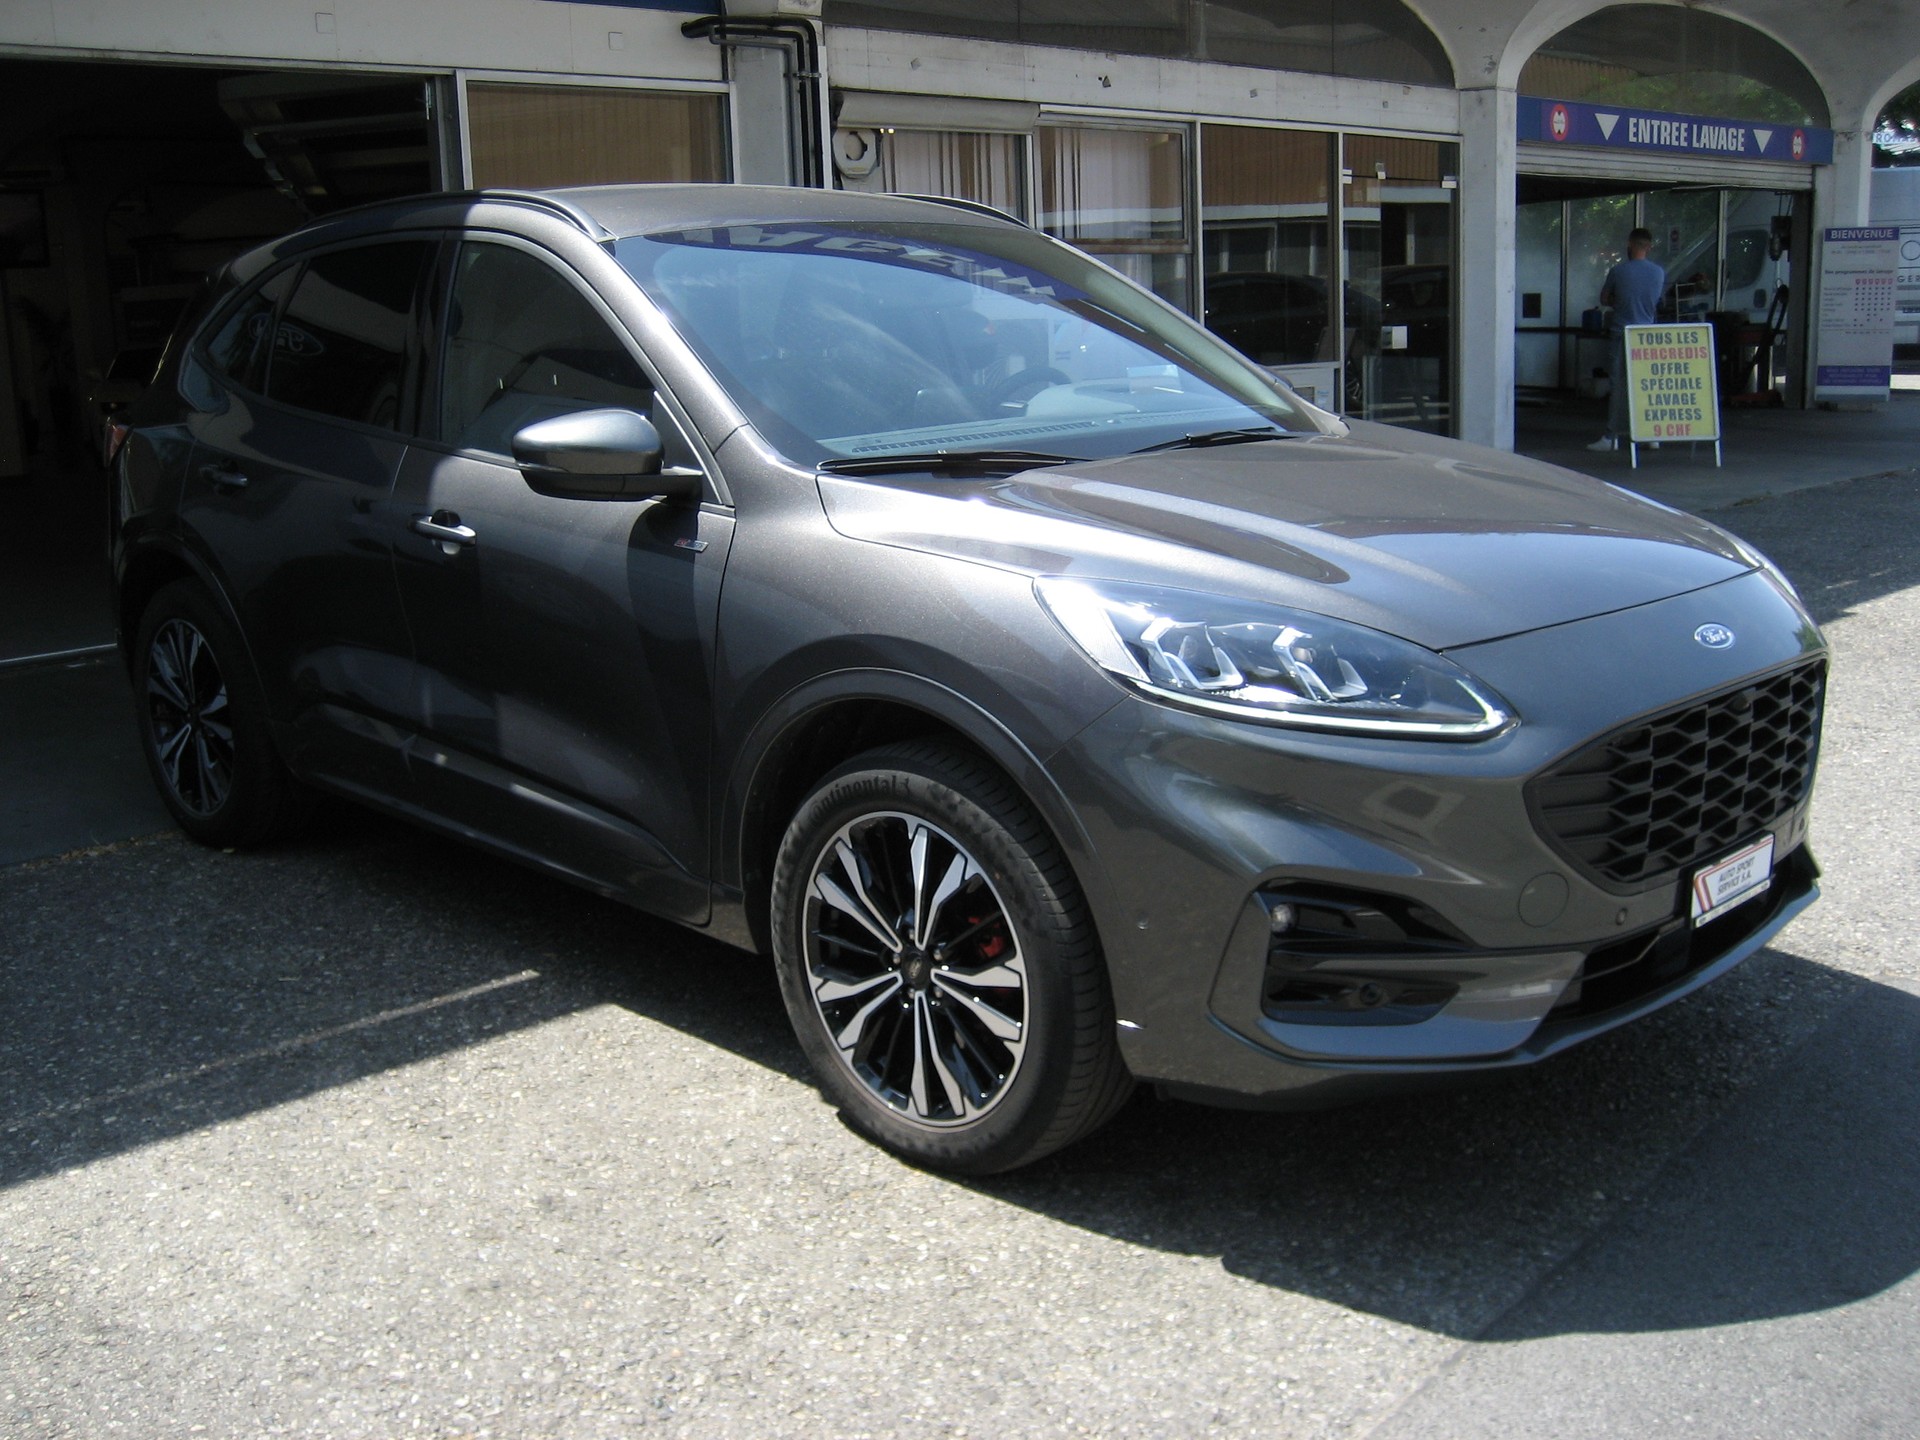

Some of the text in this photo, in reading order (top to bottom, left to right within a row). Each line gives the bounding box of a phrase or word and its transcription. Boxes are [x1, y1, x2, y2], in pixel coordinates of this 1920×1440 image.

[1628, 117, 1745, 151] ENTREE LAVAGE
[1831, 229, 1893, 239] BIENVENUE
[1637, 331, 1699, 345] TOUS LES
[1631, 346, 1708, 360] MERCREDIS
[1651, 362, 1690, 375] OFFRE
[1648, 393, 1697, 406] LAVAGE
[1644, 408, 1702, 421] EXPRESS
[1654, 423, 1692, 437] 9 CHF
[1702, 628, 1728, 644] Ford
